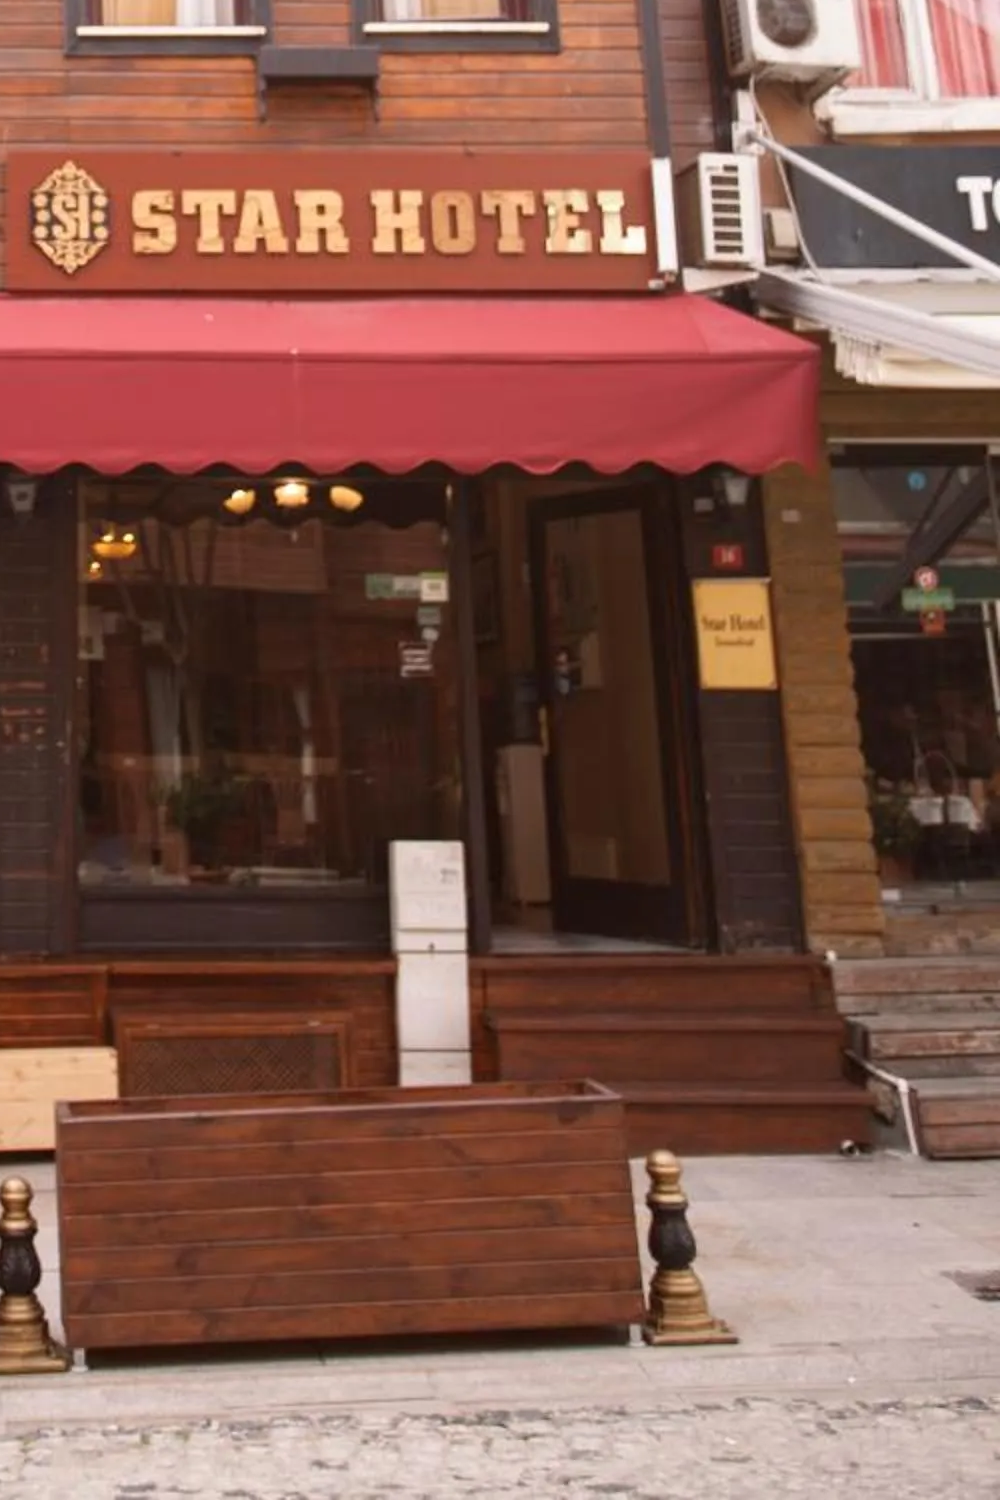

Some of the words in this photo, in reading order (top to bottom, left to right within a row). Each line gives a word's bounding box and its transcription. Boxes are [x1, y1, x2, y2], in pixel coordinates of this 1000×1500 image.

[131, 188, 350, 256] STAR
[370, 187, 648, 256] HOTEL
[956, 175, 1000, 231] T
